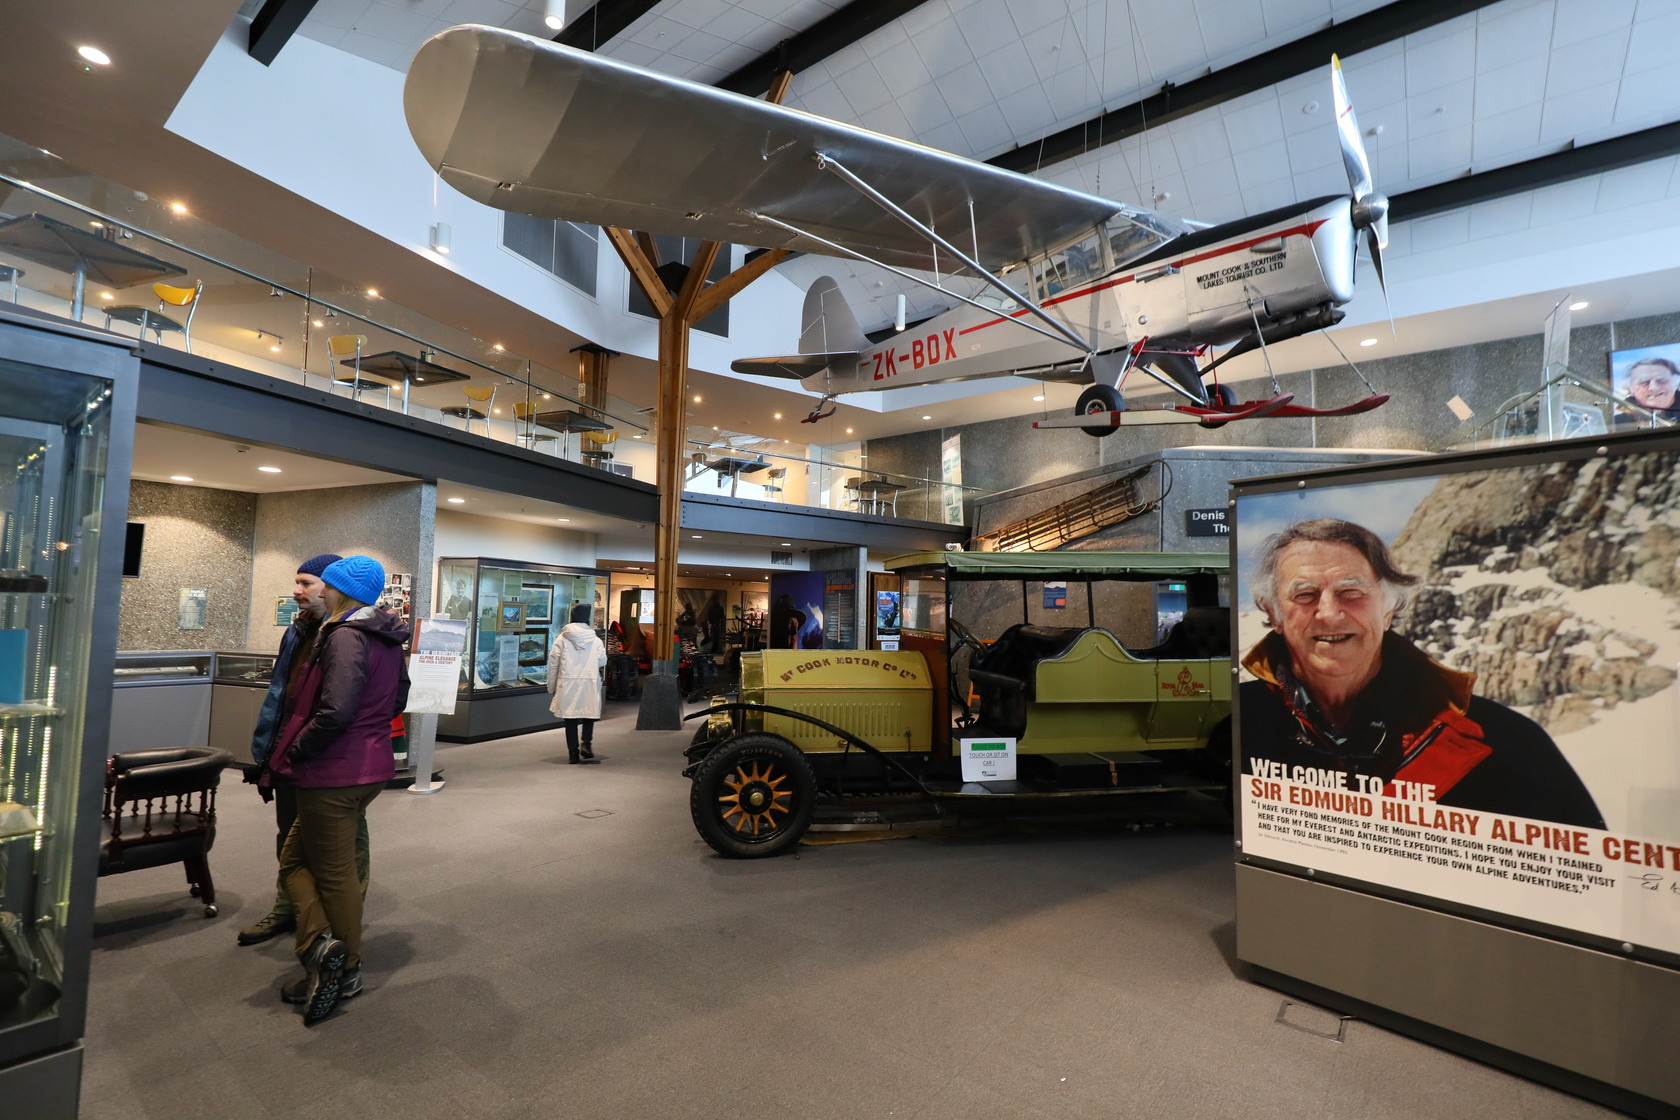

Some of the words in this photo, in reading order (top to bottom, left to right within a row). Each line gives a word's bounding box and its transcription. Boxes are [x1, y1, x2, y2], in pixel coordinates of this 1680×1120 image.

[1196, 271, 1219, 283] MOUNT
[1222, 264, 1242, 276] COOK
[1251, 251, 1287, 268] SOUTHERN
[1203, 279, 1224, 289] LAKES
[1226, 270, 1253, 284] TOURIST
[1270, 261, 1284, 271] LTD
[873, 327, 957, 381] ZK-BDX
[1192, 510, 1225, 521] Denis
[796, 658, 831, 674] COOK
[835, 656, 880, 668] MOTOR
[1250, 757, 1348, 791] WELCOME
[1355, 773, 1384, 796] TO
[1391, 779, 1437, 804] THE
[1251, 778, 1282, 801] SIR
[1289, 785, 1373, 817] EDMUND
[1382, 801, 1479, 836] HILLARY
[1491, 818, 1590, 856] ALPINE
[1262, 803, 1279, 812] HAVE
[1281, 806, 1298, 816] VERY
[1300, 810, 1318, 820] FOND
[1320, 814, 1359, 828] MEMORIES
[1362, 821, 1371, 829] OF
[1374, 823, 1389, 833] THE
[1392, 827, 1421, 839] MOUNT
[1424, 832, 1448, 844] COOK
[1451, 837, 1483, 850] REGION
[1487, 844, 1513, 856] FROM
[1517, 849, 1546, 862] WHEN
[1556, 856, 1603, 873] TRAINED
[1257, 812, 1275, 821] HERE
[1277, 815, 1290, 824] FOR
[1292, 818, 1302, 827] MY
[1304, 820, 1337, 834] EVEREST
[1339, 828, 1354, 837] AND
[1357, 830, 1401, 846] ANTARCTIC
[1403, 840, 1463, 859] EXPEDITIONS.
[1471, 853, 1495, 864] HOPE
[1499, 858, 1517, 869] YOU
[1520, 862, 1552, 875] ENJOY
[1556, 868, 1583, 882] YOUR
[1587, 875, 1616, 888] VISIT
[1258, 822, 1271, 831] AND
[1274, 825, 1290, 834] THAT
[1293, 828, 1306, 837] YOU
[1308, 832, 1322, 841] ARE
[1324, 835, 1358, 848] INSPIRED
[1361, 842, 1371, 851] TO
[1373, 845, 1423, 862] EXPERIENCE
[1426, 855, 1448, 867] YOUR
[1451, 860, 1472, 871] OWN
[1475, 865, 1509, 879] ALPINE
